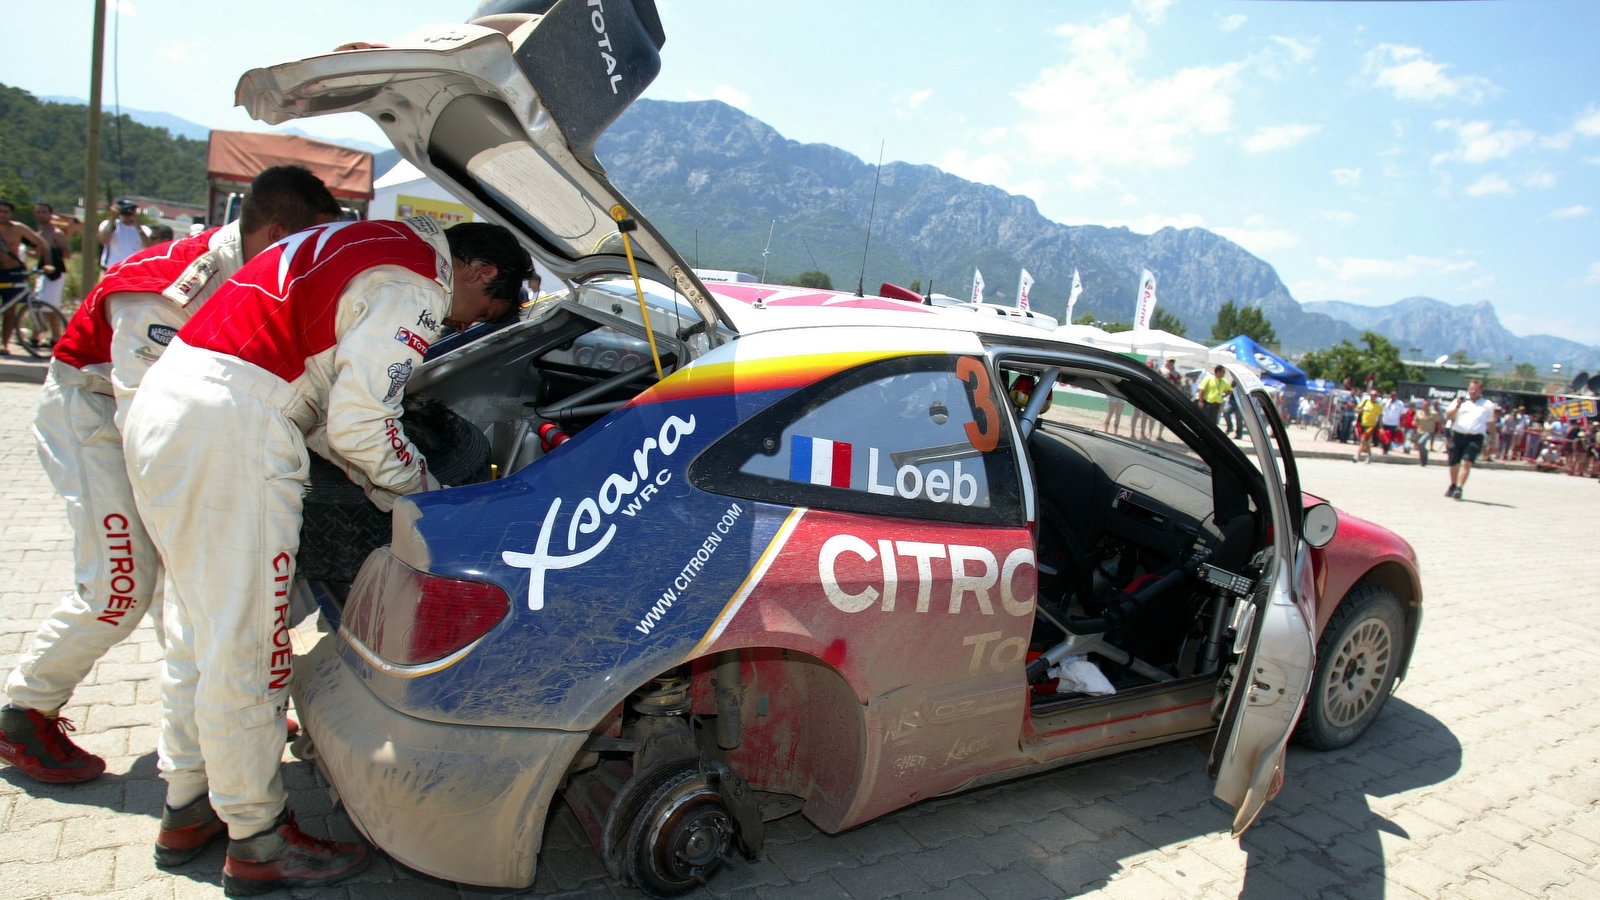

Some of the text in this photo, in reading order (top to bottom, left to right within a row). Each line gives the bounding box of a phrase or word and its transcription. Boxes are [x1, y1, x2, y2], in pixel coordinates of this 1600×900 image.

[588, 0, 622, 94] TOTAL
[956, 356, 999, 452] 3
[501, 413, 696, 611] Xsara
[621, 468, 672, 517] WRC
[867, 447, 978, 506] Loeb
[97, 513, 138, 627] CITROËN
[818, 534, 1036, 617] CITRO
